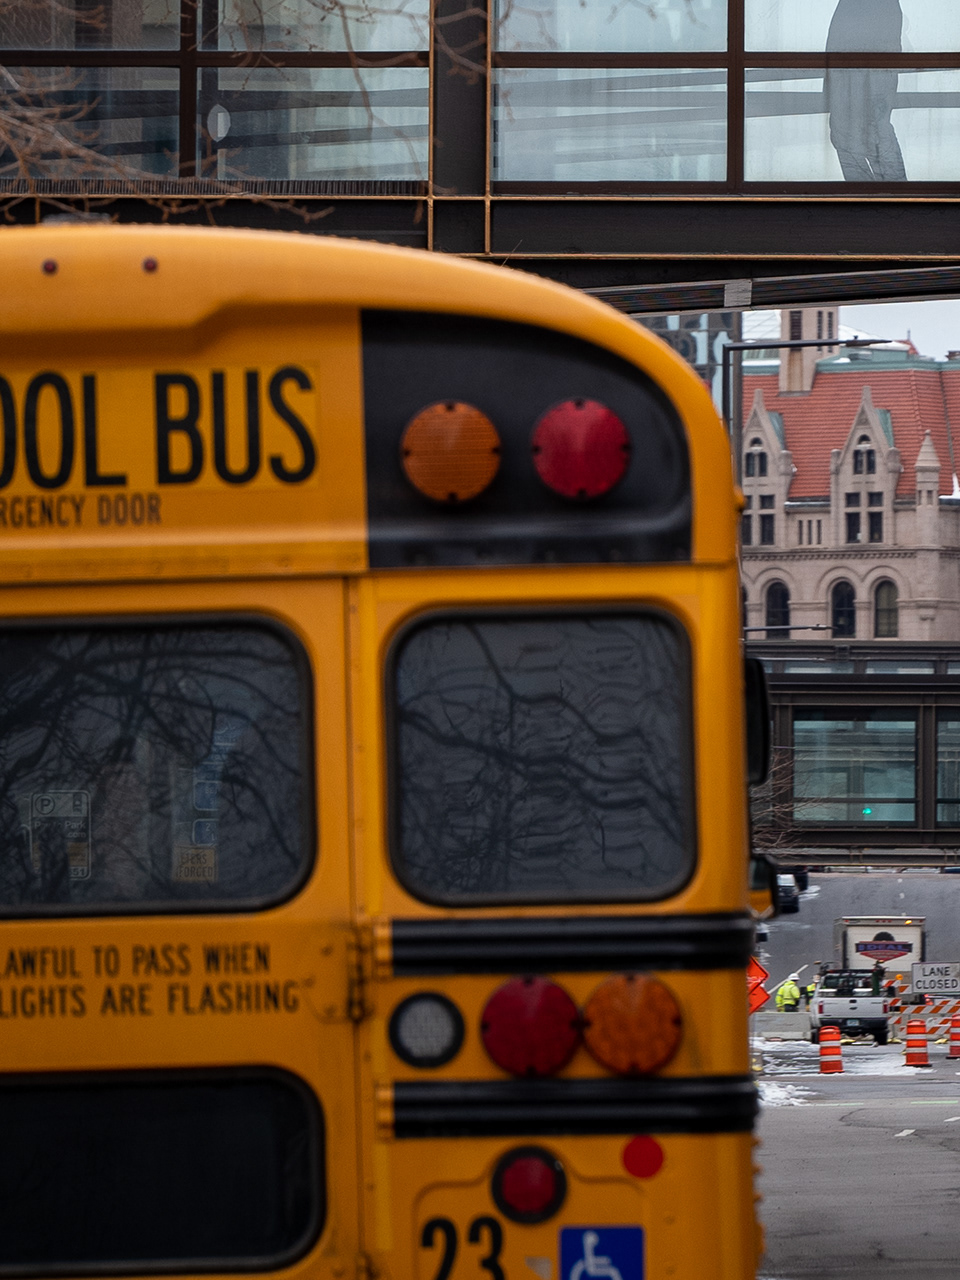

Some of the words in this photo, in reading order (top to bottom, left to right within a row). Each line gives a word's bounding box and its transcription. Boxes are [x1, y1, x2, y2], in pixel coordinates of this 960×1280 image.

[155, 365, 317, 484] BUS
[97, 492, 162, 526] DOOR
[2, 945, 81, 979] AWFUL
[92, 943, 121, 978] TO
[131, 942, 191, 977] PASS
[201, 940, 271, 975] WHEN
[922, 966, 950, 977] LANE
[101, 982, 153, 1016] ARE
[167, 980, 300, 1015] FLASHING
[915, 978, 958, 990] CLOSED
